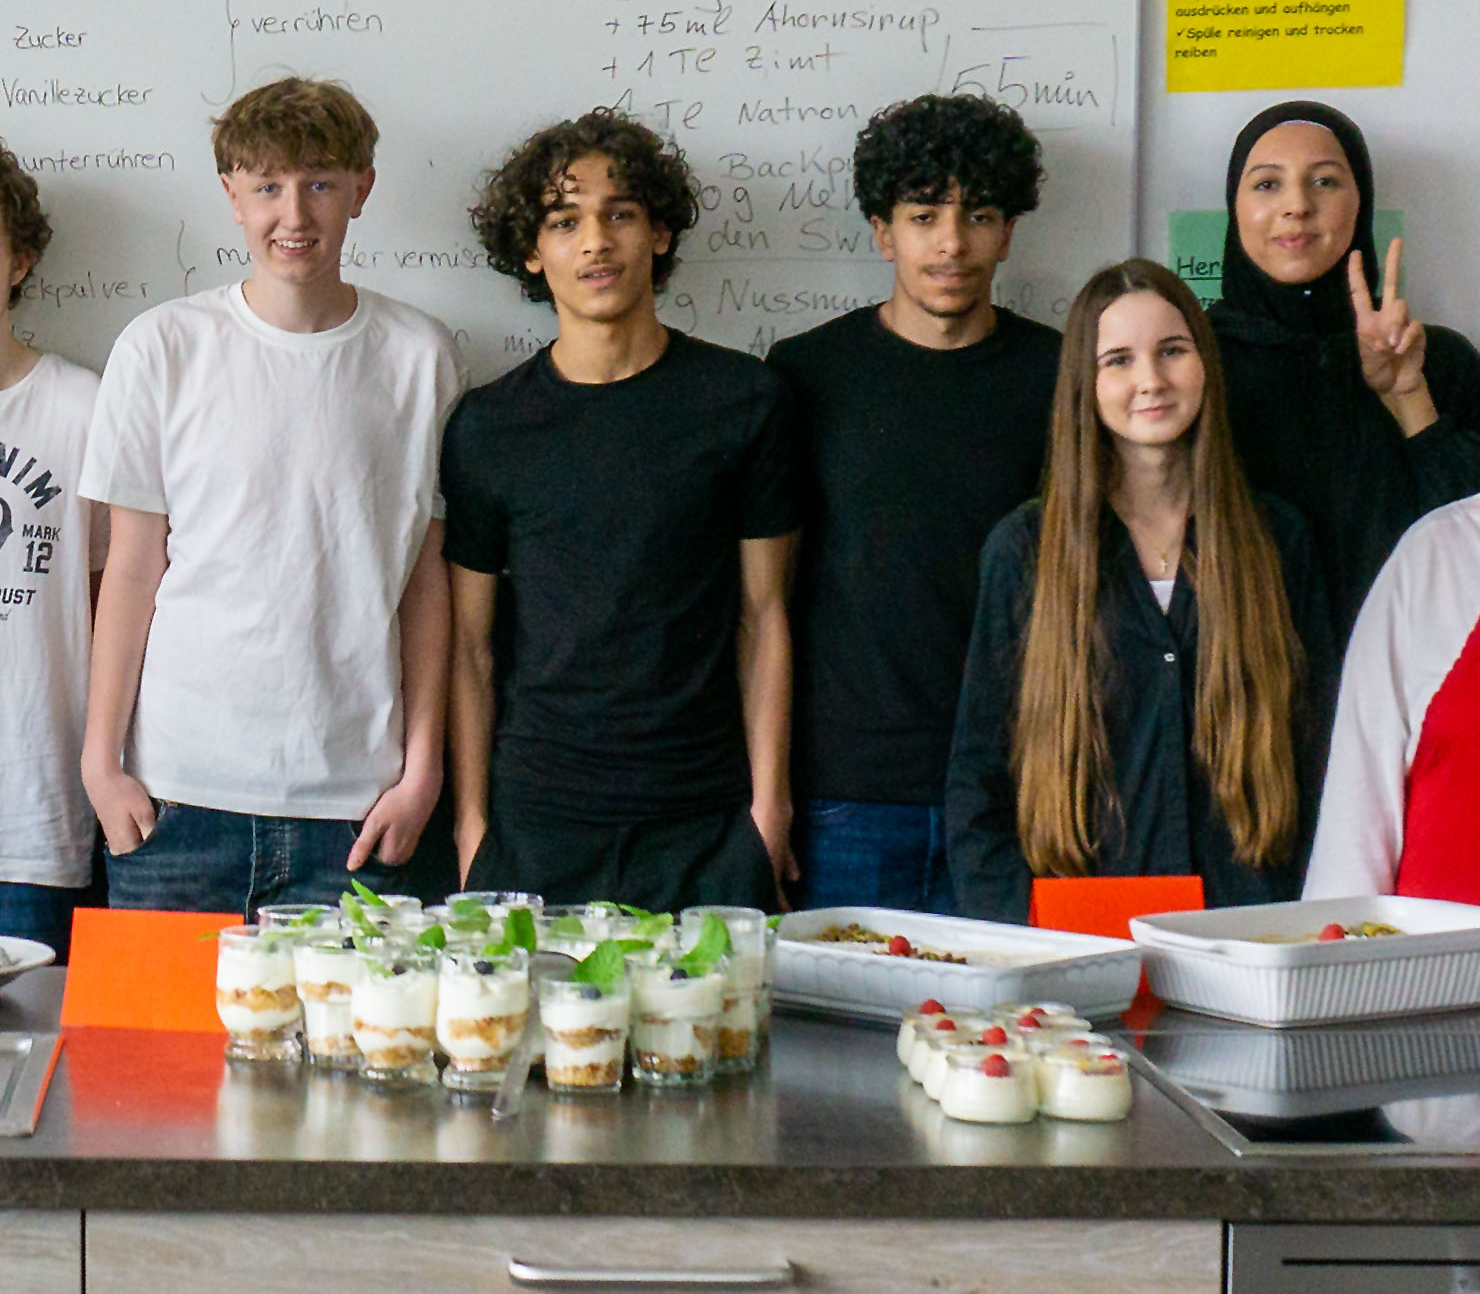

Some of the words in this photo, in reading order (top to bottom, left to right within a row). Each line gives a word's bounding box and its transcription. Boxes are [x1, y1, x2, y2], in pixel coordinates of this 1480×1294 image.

[252, 8, 383, 34] verrühren
[1175, 5, 1248, 17] ausdrücken
[1254, 4, 1276, 15] und
[1282, 2, 1350, 15] aufhängen
[13, 25, 87, 50] Zucker
[1186, 28, 1222, 41] Spüle
[1227, 27, 1279, 40] reinigen
[1285, 26, 1307, 37] und
[1313, 24, 1364, 36] trocken
[745, 43, 842, 71] Zimt
[1174, 46, 1217, 58] reiben
[2, 78, 153, 107] Vanillezucker
[738, 97, 858, 125] Natron
[1178, 256, 1220, 275] Her
[22, 524, 61, 541] MARK
[23, 541, 53, 574] 12
